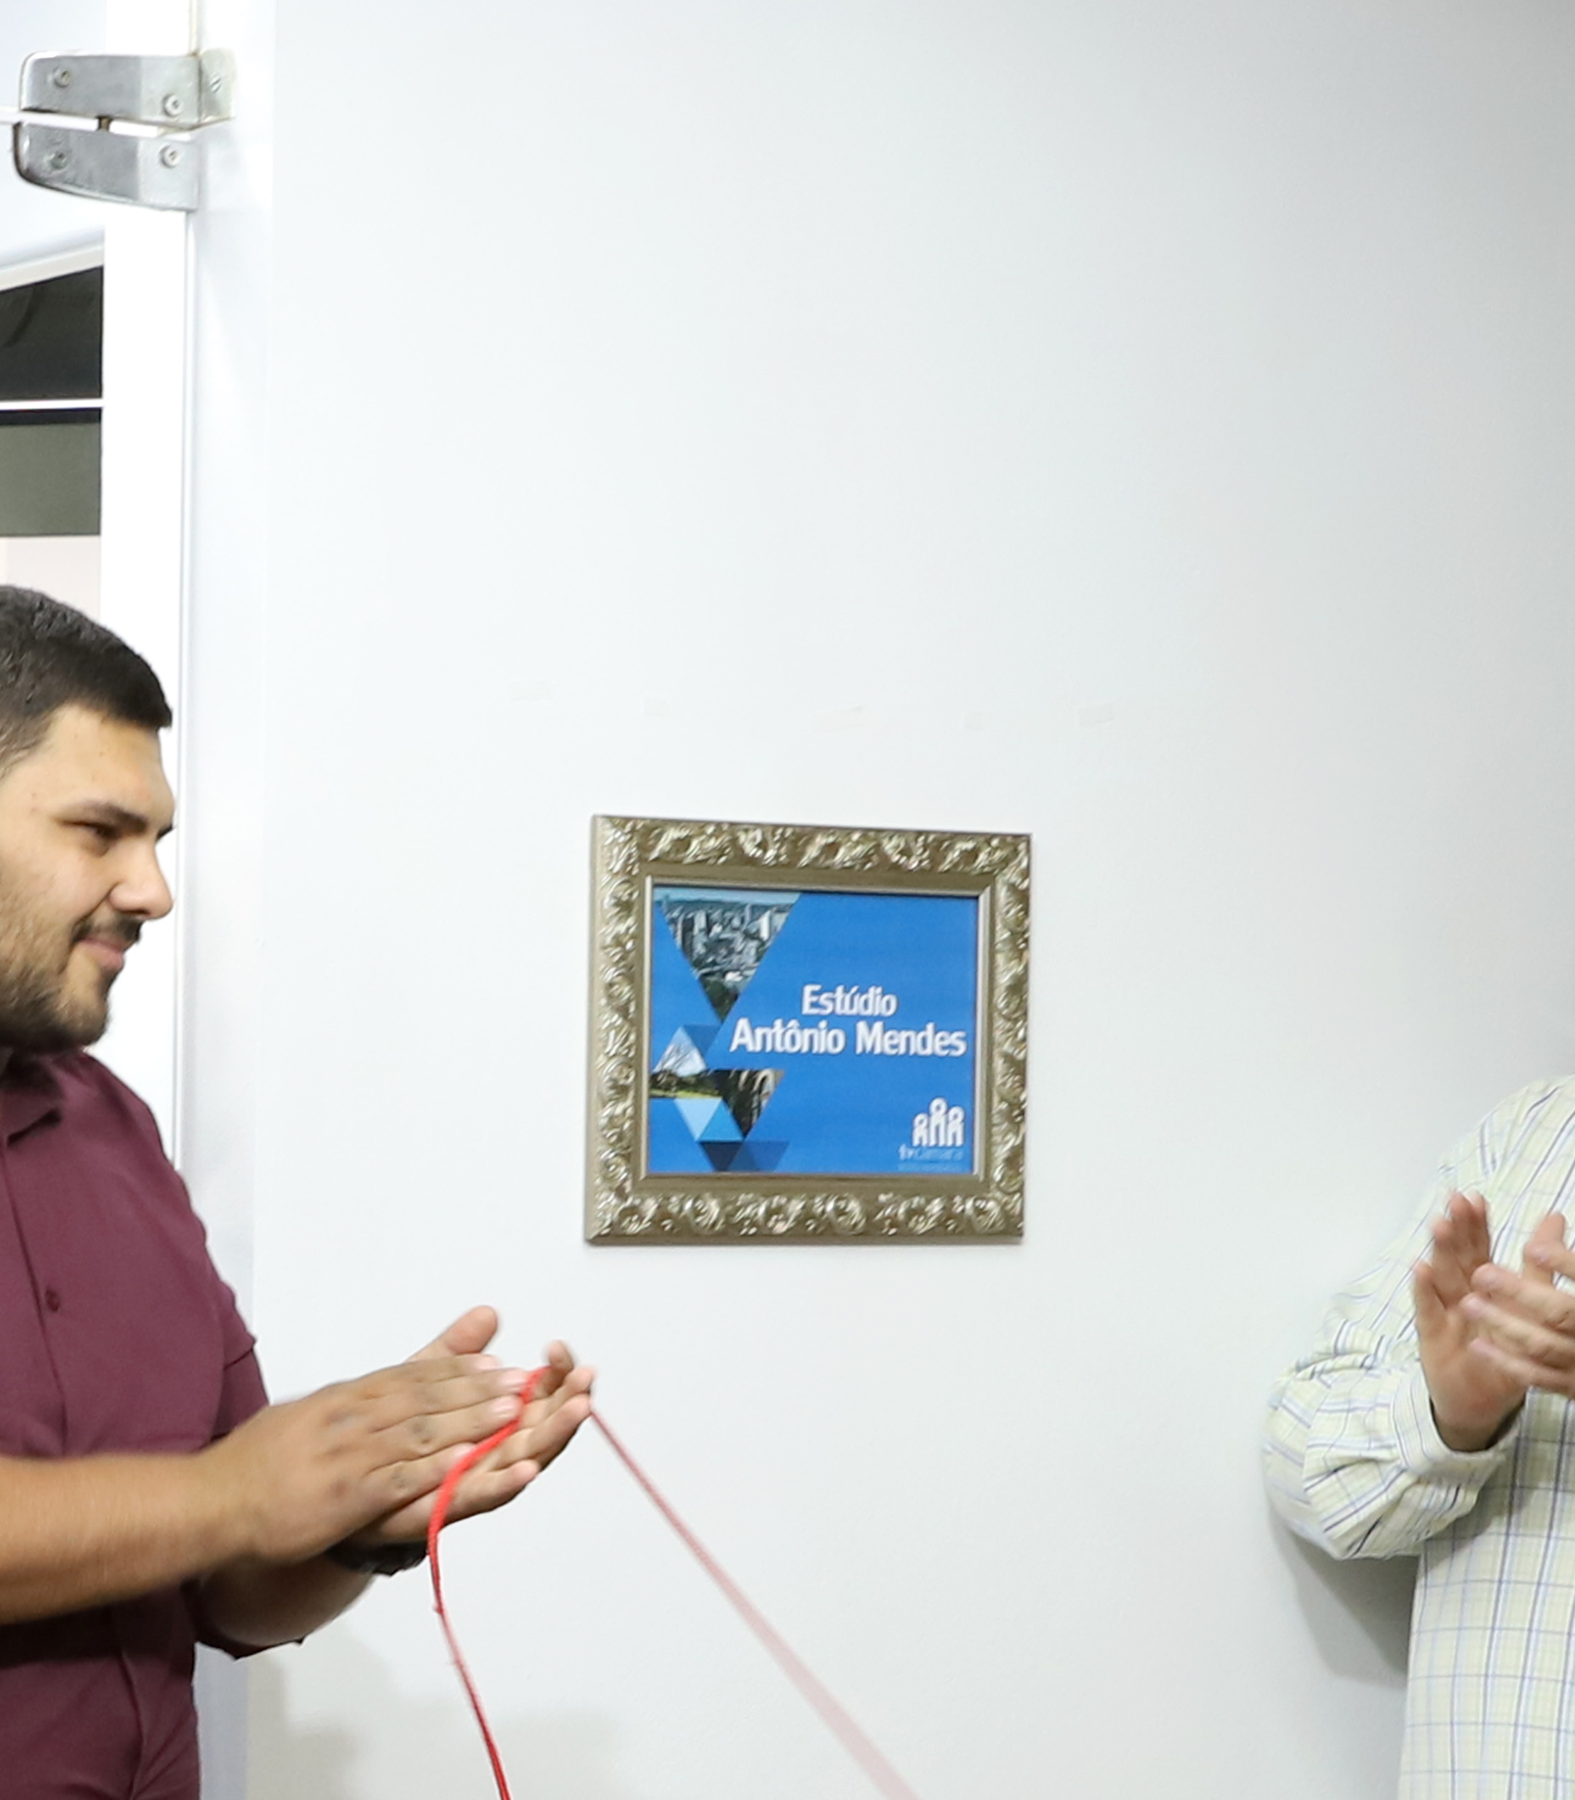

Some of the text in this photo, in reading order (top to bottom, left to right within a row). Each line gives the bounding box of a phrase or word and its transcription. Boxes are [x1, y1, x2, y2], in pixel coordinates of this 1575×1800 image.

[802, 983, 898, 1017] Estúdio
[729, 1017, 968, 1057] Antônio Mendes
